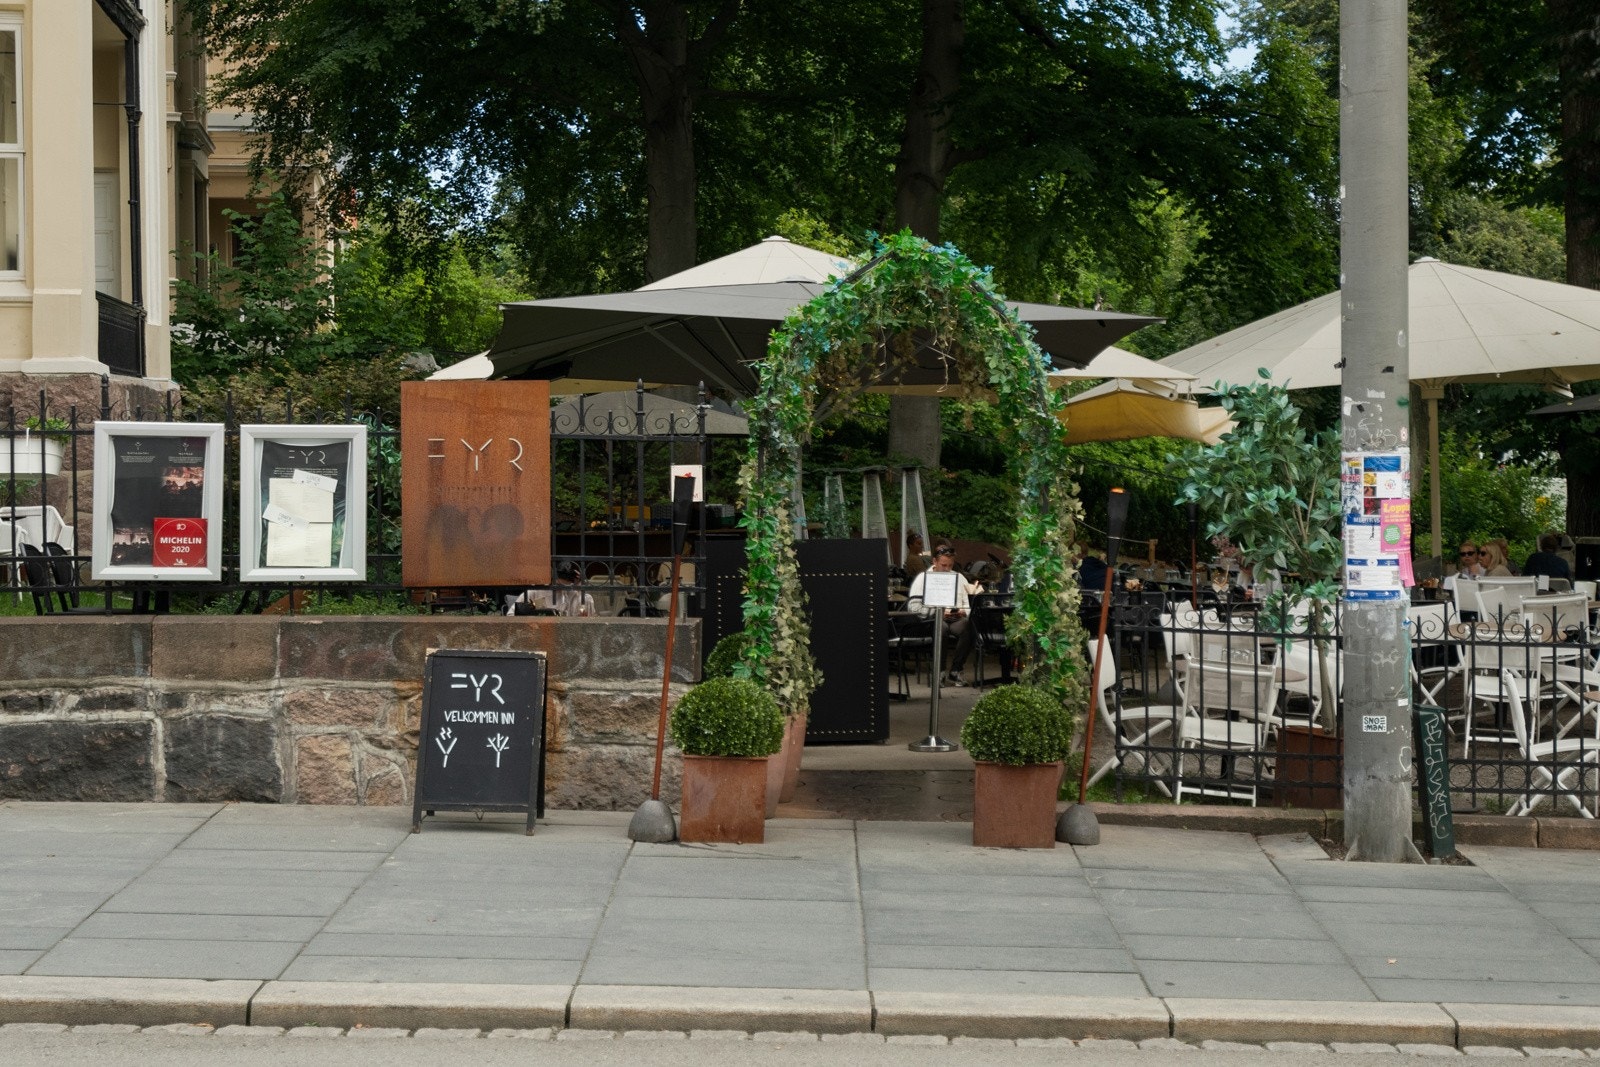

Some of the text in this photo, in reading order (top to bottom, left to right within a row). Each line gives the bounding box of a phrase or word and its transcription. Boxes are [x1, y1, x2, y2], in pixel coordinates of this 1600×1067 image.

[160, 536, 202, 544] MICHELIN
[171, 545, 190, 553] 2020
[444, 710, 515, 725] VELKOMMEN INN
